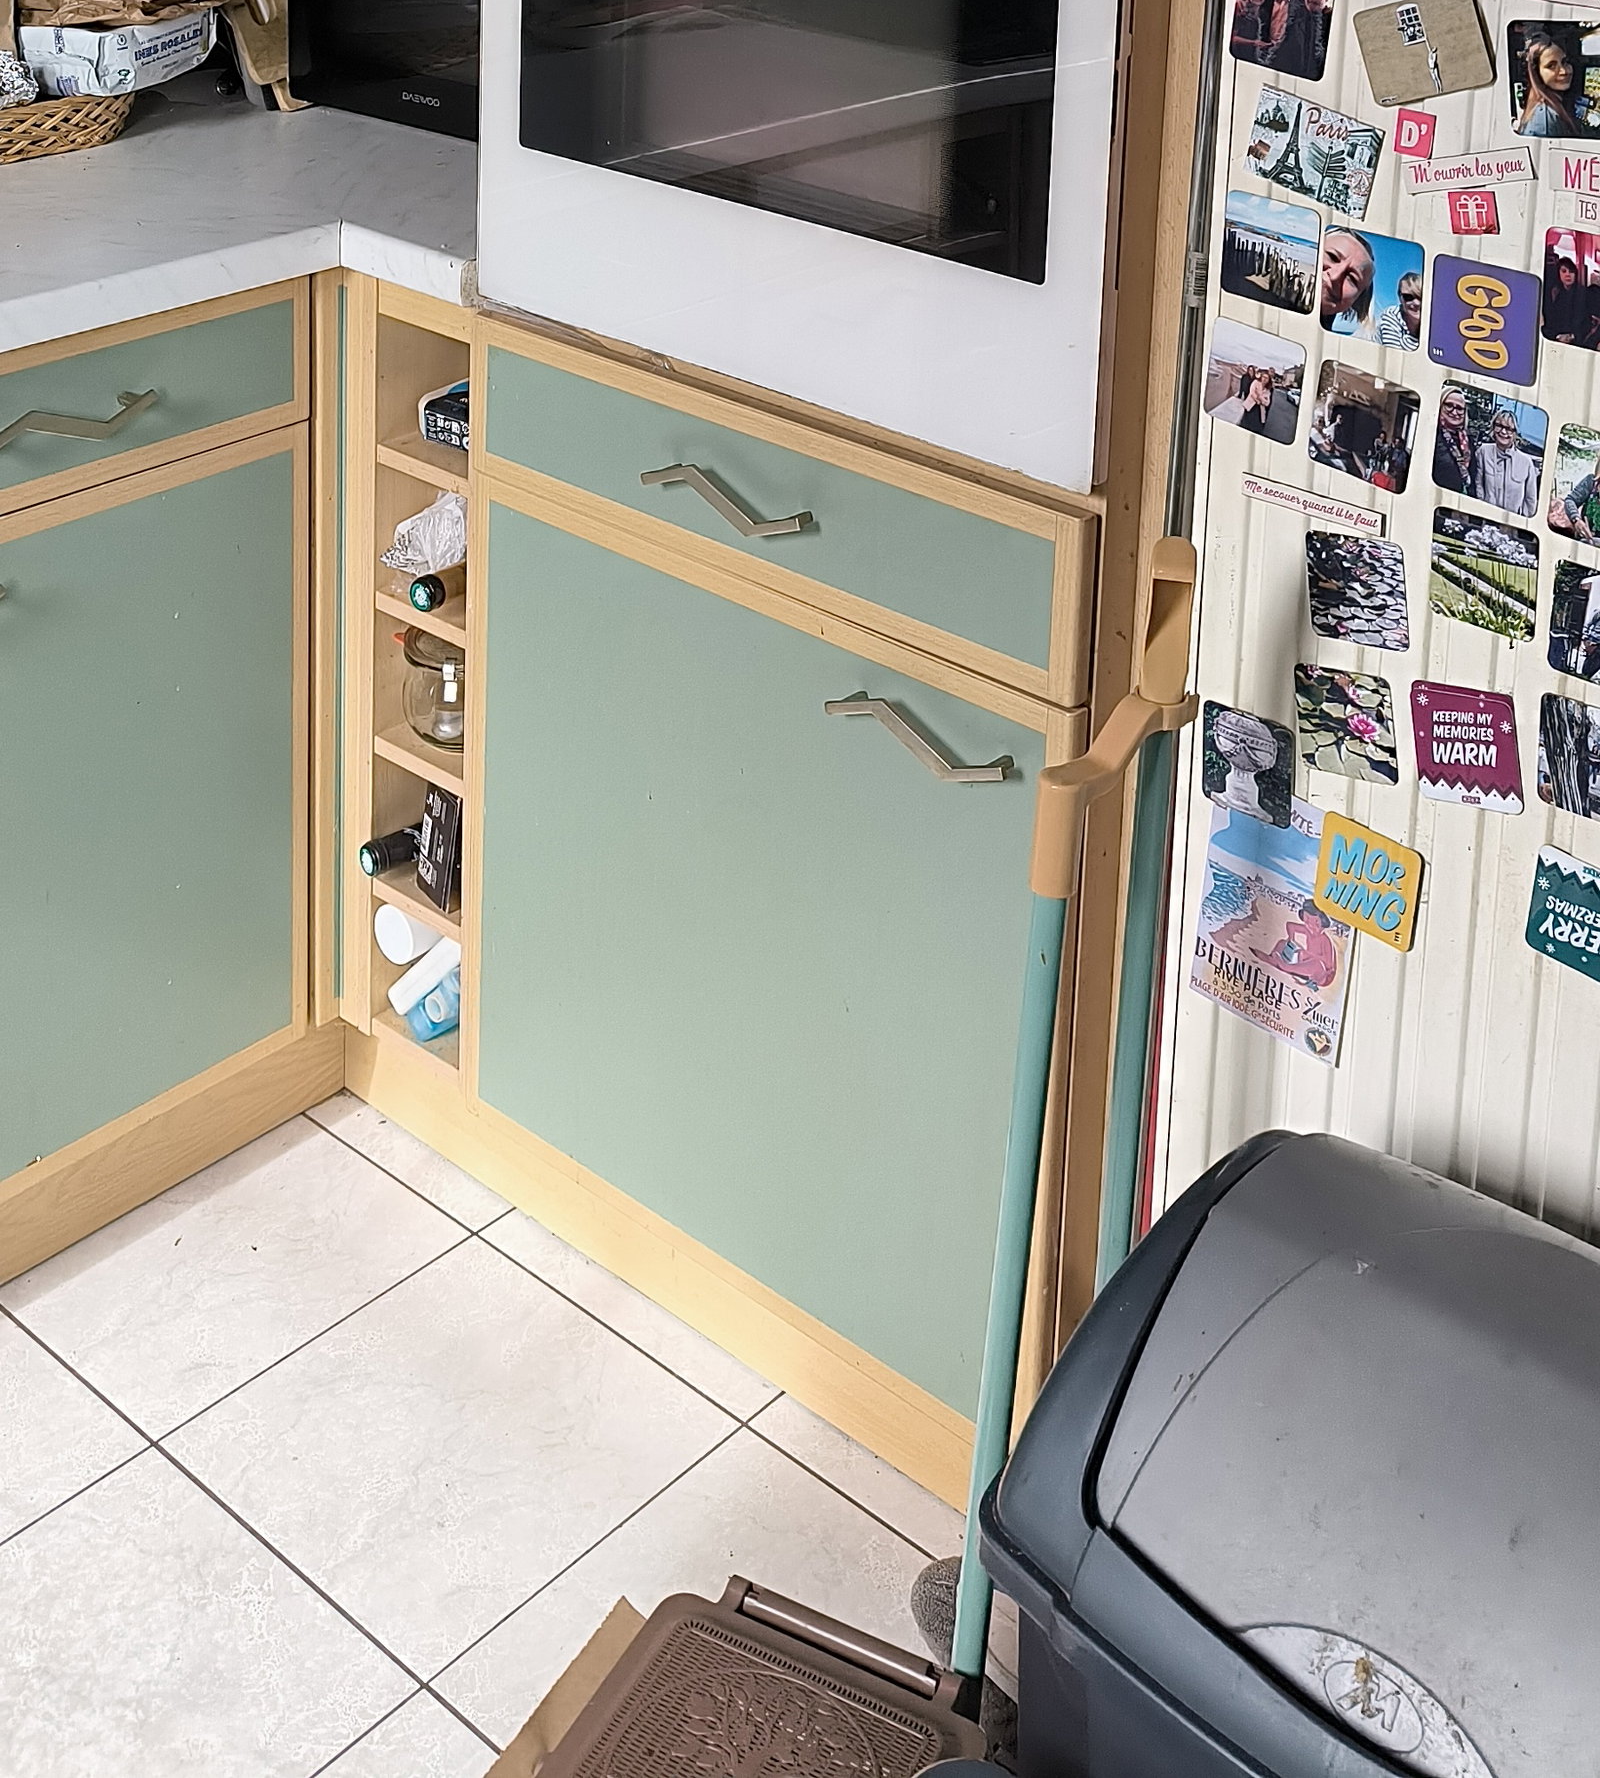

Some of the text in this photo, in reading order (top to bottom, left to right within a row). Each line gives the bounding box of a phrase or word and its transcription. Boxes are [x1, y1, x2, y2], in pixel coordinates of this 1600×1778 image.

[402, 91, 440, 107] DAEWOO
[1305, 106, 1350, 142] Paris
[1400, 119, 1428, 148] D'
[1475, 157, 1493, 177] les
[1497, 158, 1526, 181] yeux
[1578, 199, 1598, 221] TES
[1456, 273, 1512, 370] GOOD
[1244, 479, 1263, 494] Me
[1263, 486, 1301, 505] secouer
[1302, 498, 1335, 516] quand
[1345, 509, 1355, 522] le
[1354, 513, 1378, 528] faut
[1432, 710, 1493, 725] KEEPING MY
[1432, 724, 1495, 742] MEMORIES
[1432, 740, 1498, 768] WARM
[1328, 833, 1406, 891] MOR
[1323, 876, 1407, 932] NING
[1538, 912, 1600, 955] ERRY
[1213, 966, 1282, 1011] RIVE PLAGE
